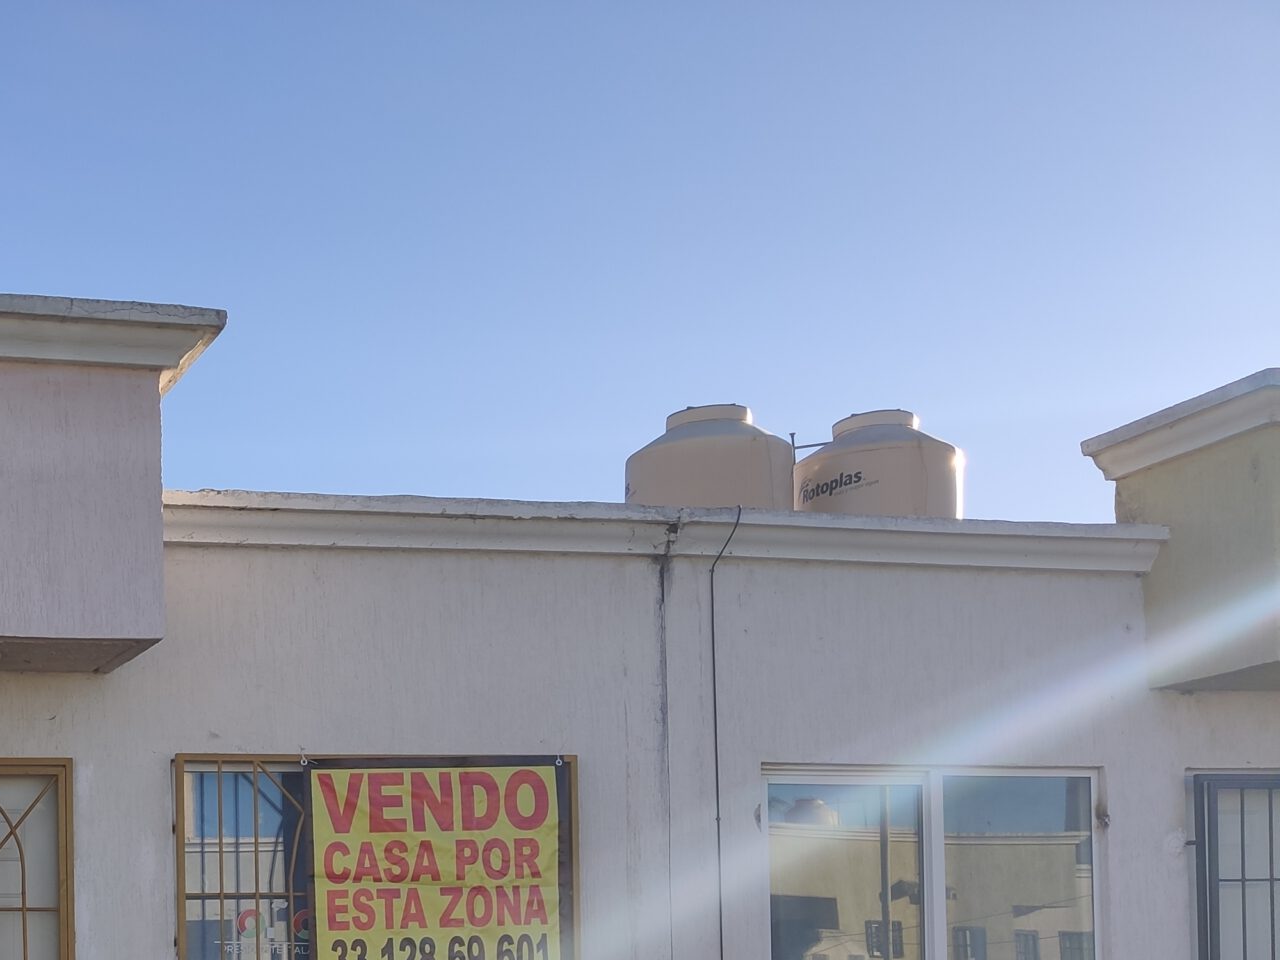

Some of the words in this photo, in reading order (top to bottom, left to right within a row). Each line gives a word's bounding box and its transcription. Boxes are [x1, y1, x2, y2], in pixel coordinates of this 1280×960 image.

[802, 471, 862, 504] Rotoplas
[317, 769, 549, 833] VENDO
[323, 840, 441, 884] CASA
[455, 837, 542, 881] POR
[326, 887, 428, 931] ESTA
[439, 885, 548, 929] ZONA
